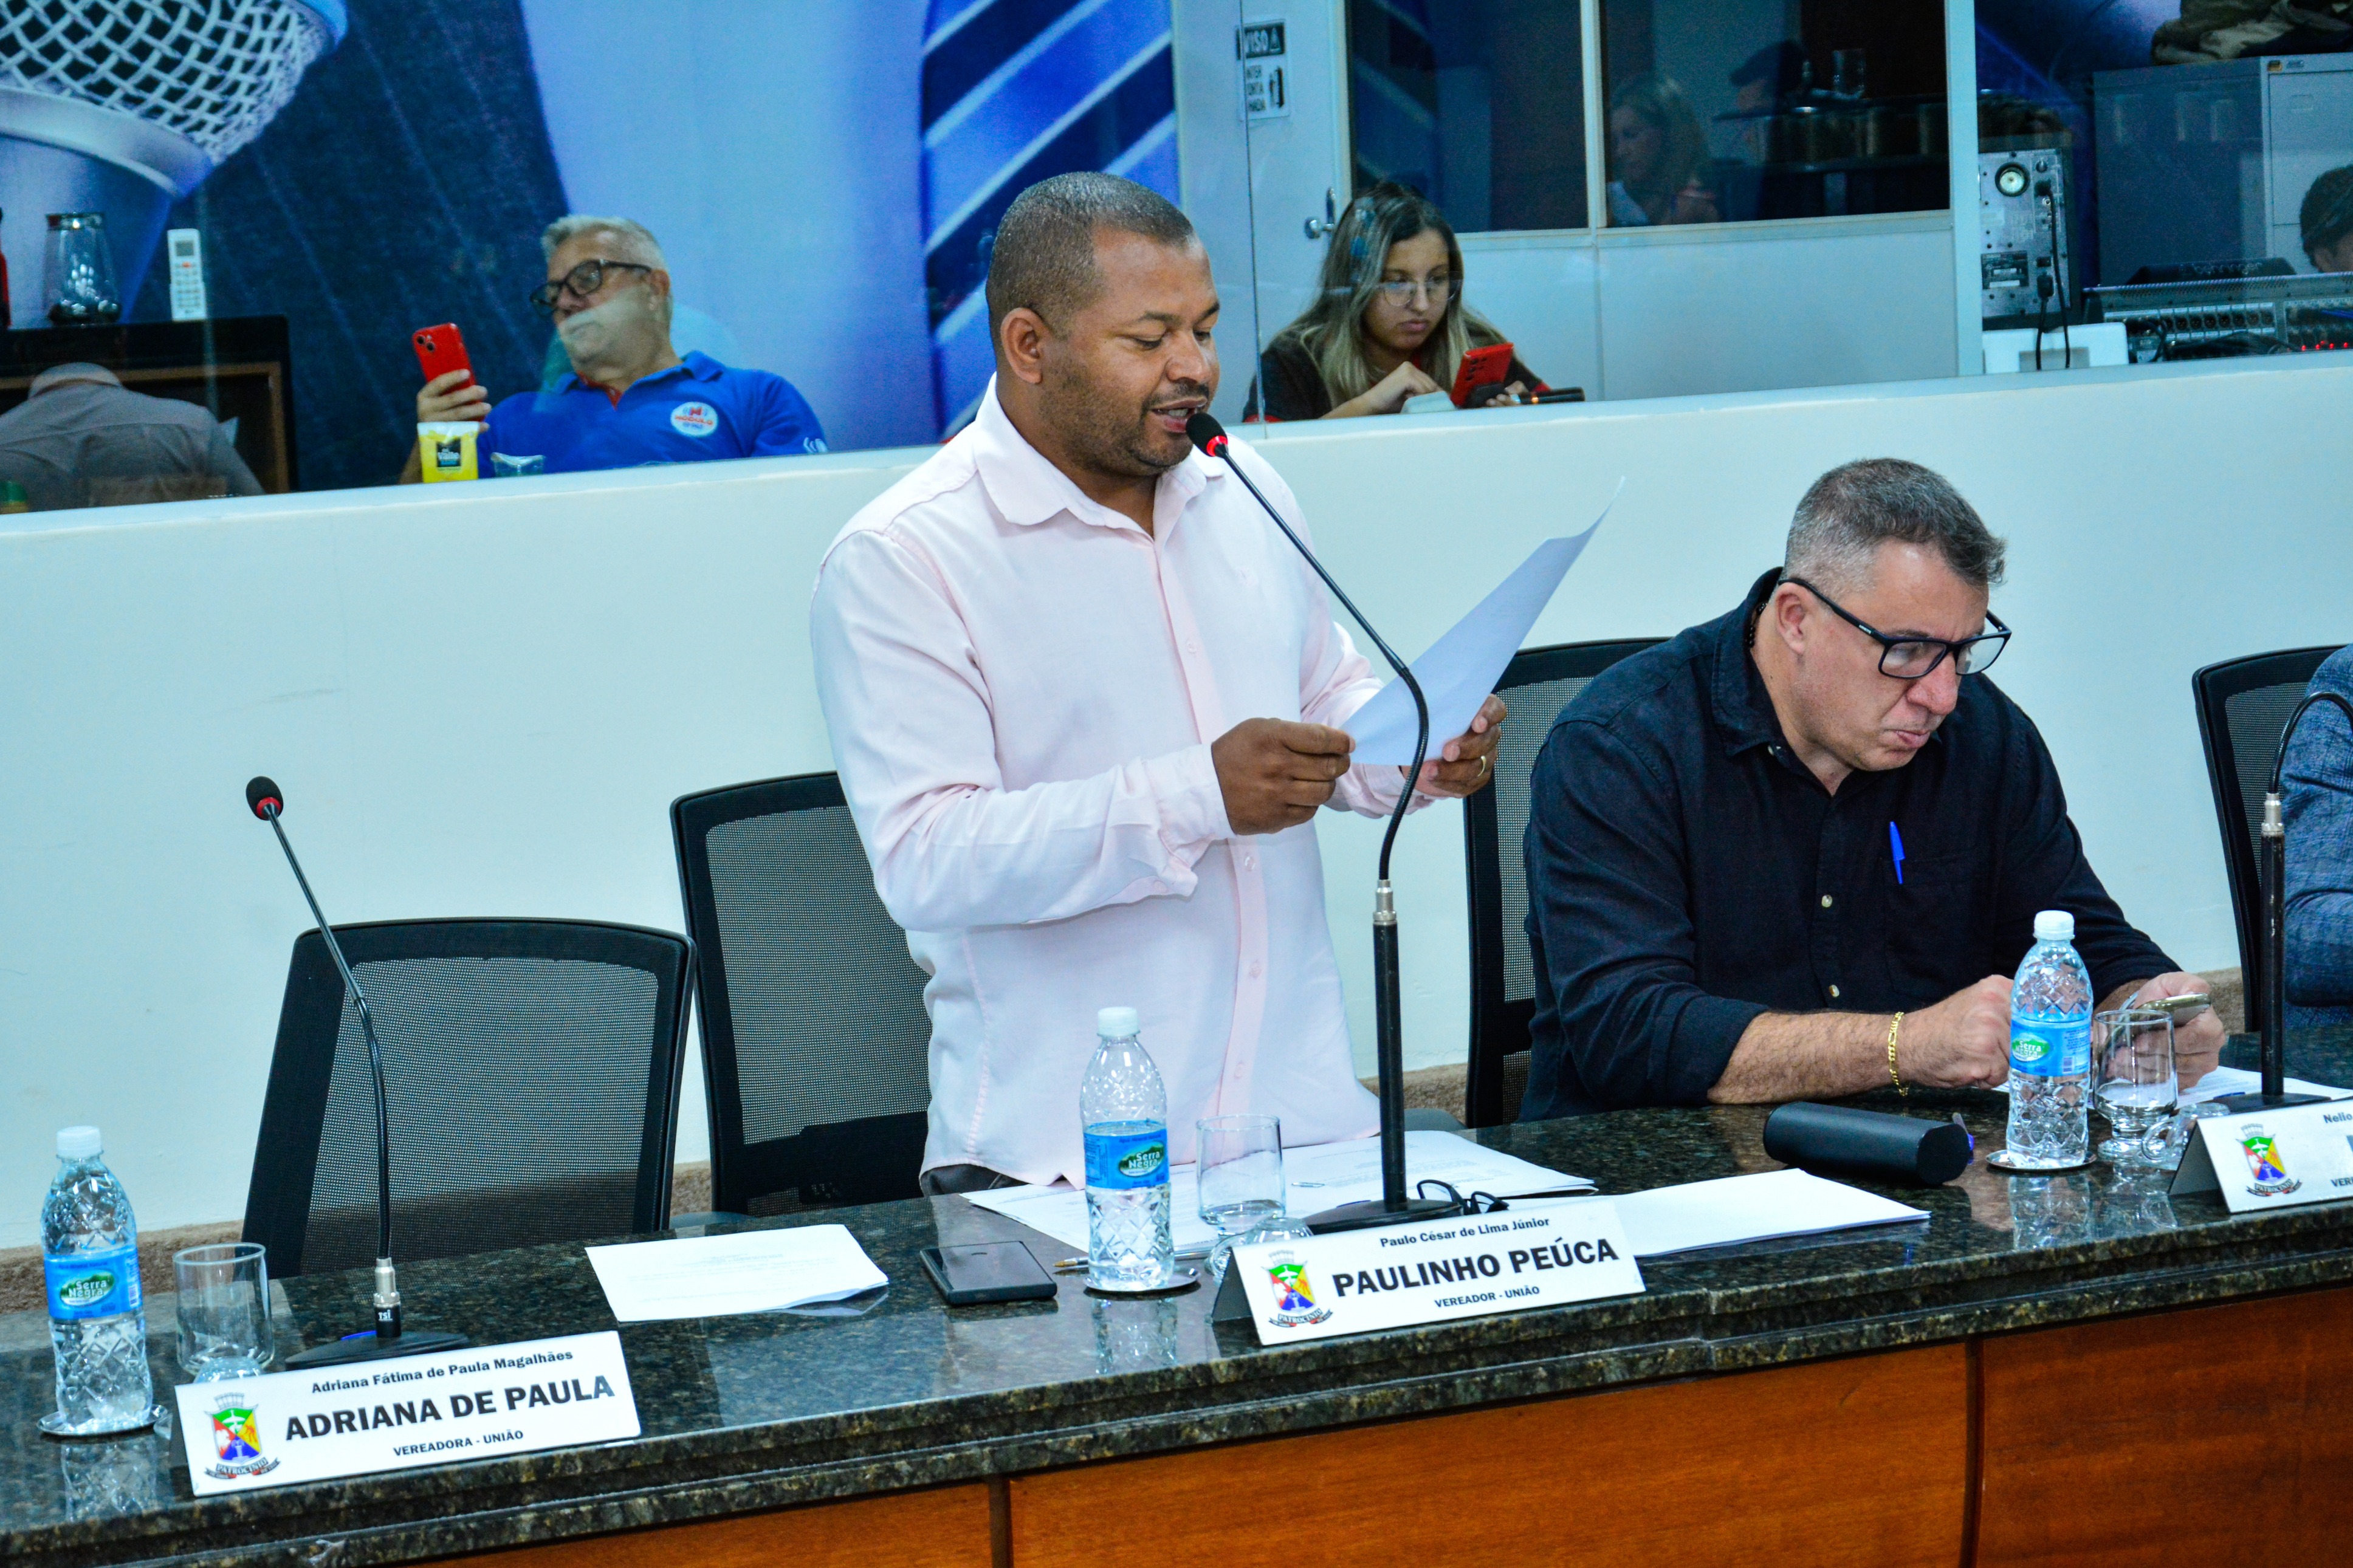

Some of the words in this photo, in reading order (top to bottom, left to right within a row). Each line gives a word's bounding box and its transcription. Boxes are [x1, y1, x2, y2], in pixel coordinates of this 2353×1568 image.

[2015, 1045, 2038, 1058] Negra
[2019, 1040, 2042, 1052] Serra
[2323, 1112, 2352, 1123] Nelio
[1136, 1151, 1160, 1161] Serra
[1128, 1159, 1158, 1169] Negra
[1379, 1234, 1417, 1247] Paulo
[1420, 1231, 1456, 1242] César
[1460, 1227, 1475, 1237] de
[1478, 1224, 1509, 1234] Lima
[1512, 1217, 1550, 1230] Júnior
[1331, 1254, 1500, 1297] PAULINHO
[1508, 1236, 1620, 1273] PEÚCA
[76, 1280, 107, 1290] Serra
[69, 1287, 103, 1299] Negra
[1434, 1292, 1497, 1308] VEREADOR
[1504, 1285, 1540, 1298] UNIÃO
[312, 1379, 369, 1393] Adriana
[373, 1371, 423, 1385] Fátima
[427, 1368, 445, 1378] de
[448, 1361, 490, 1375] Paula
[493, 1351, 573, 1369] Magalhães
[286, 1398, 442, 1441] ADRIANA
[449, 1389, 497, 1418] DE
[504, 1375, 615, 1411] PAULA
[393, 1437, 473, 1456] VEREADORA
[483, 1429, 524, 1444] UNIÃO
